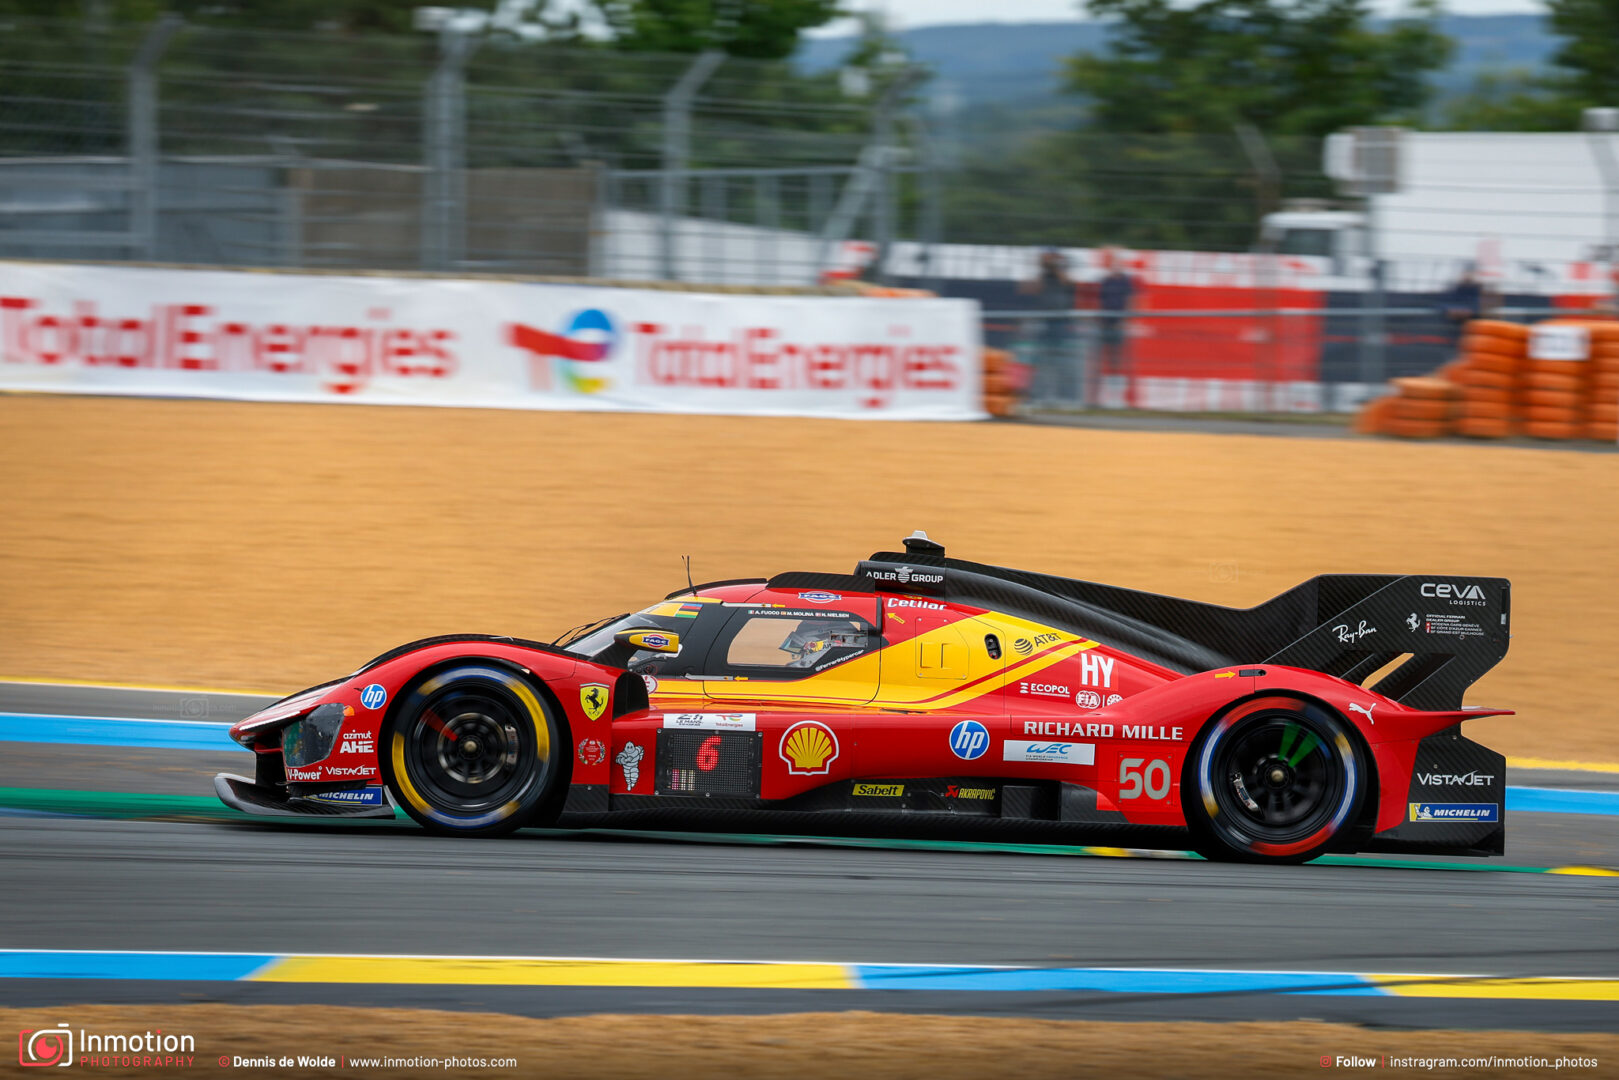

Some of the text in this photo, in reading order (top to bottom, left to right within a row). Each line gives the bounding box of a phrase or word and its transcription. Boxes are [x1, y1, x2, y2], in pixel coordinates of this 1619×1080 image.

[632, 321, 964, 408] TotalEnergies
[866, 571, 944, 583] ADLER GROUP
[887, 598, 947, 611] Cetilar
[1332, 620, 1377, 643] Ray-Ban
[1033, 632, 1062, 647] AT&T
[1081, 653, 1114, 688] HY
[1030, 683, 1070, 695] ECOPOL
[363, 685, 384, 709] hp
[1077, 693, 1098, 706] FIA
[343, 729, 372, 739] azimut
[1024, 721, 1183, 741] RICHARD MILLE
[954, 721, 985, 759] hp
[340, 741, 375, 754] AHE
[696, 735, 722, 772] 6
[1027, 743, 1073, 755] WEC
[287, 768, 321, 780] V-Power
[1118, 757, 1171, 800] 50
[858, 785, 899, 796] Sabelt
[1433, 809, 1490, 817] MICHELIN
